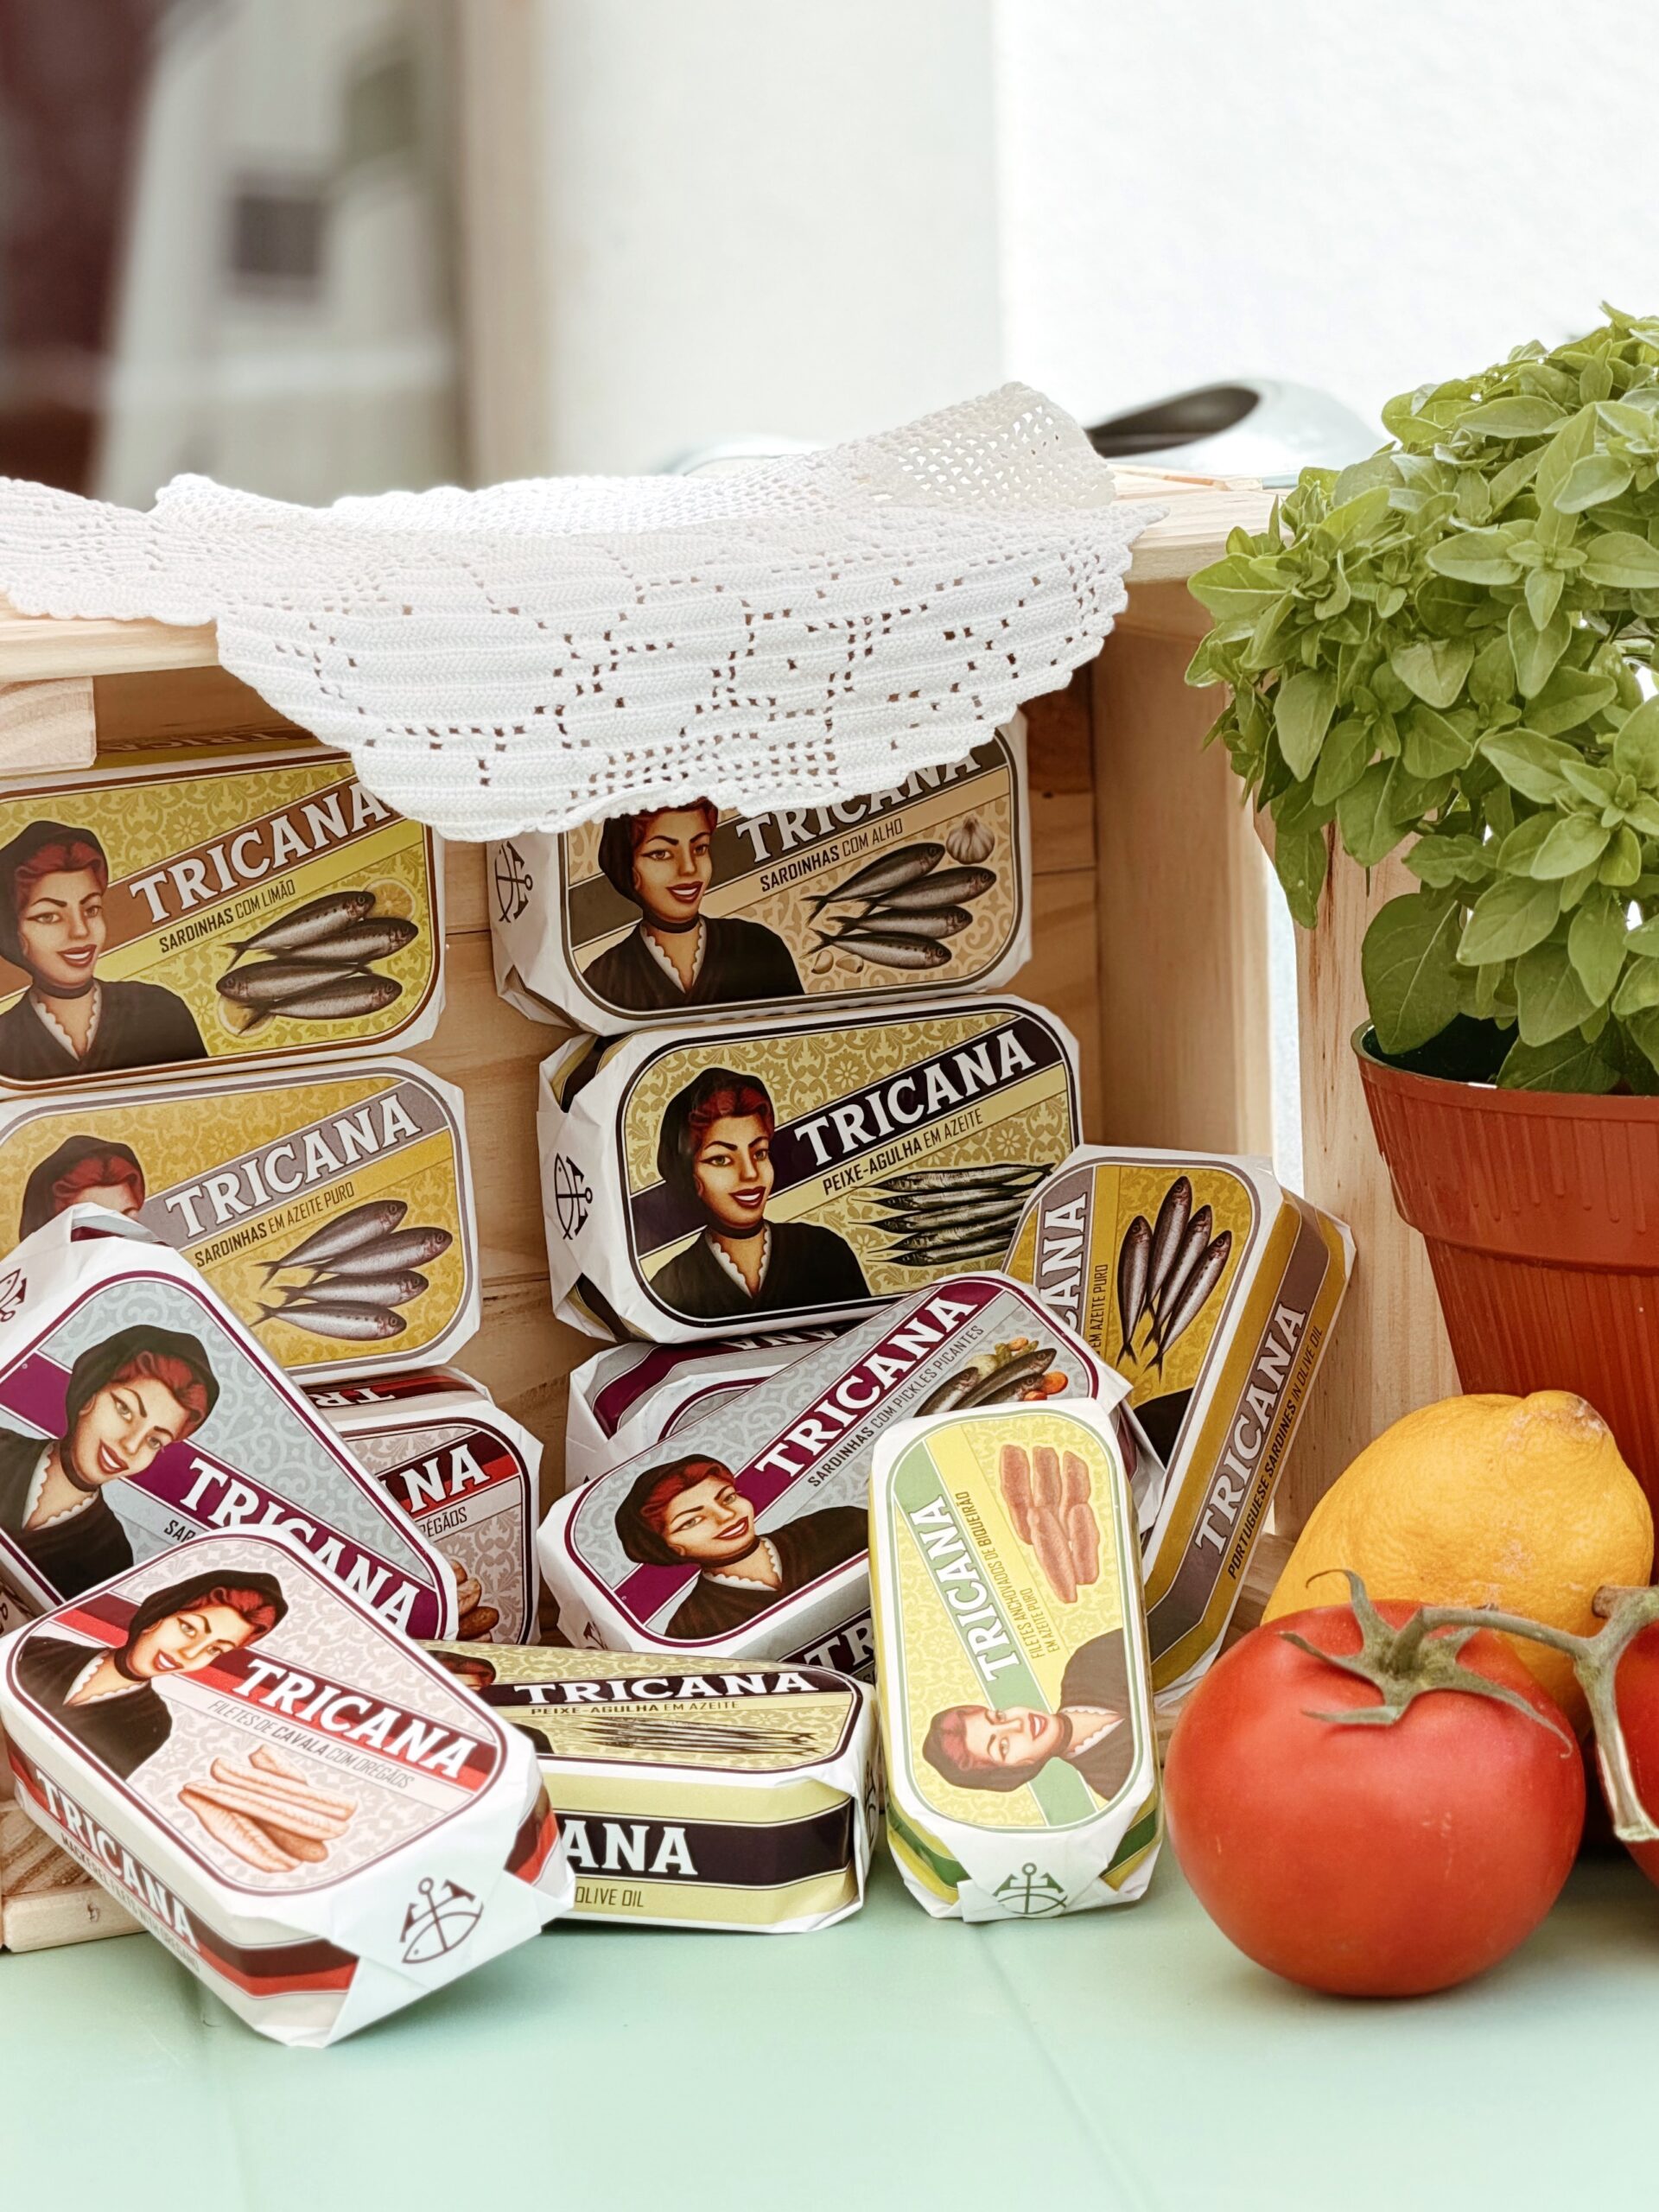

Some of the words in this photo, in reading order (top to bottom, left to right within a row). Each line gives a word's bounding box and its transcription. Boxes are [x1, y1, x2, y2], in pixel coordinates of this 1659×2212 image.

[129, 781, 391, 923] TRICANA
[760, 845, 840, 893] SARDINHAS
[842, 832, 869, 858] COM
[872, 817, 904, 850] ALHO
[160, 908, 233, 953] SARDINHAS
[235, 893, 260, 919] COM
[263, 880, 296, 907] LIMÃO
[795, 1028, 1036, 1166] TRICANA
[164, 1093, 423, 1239] TRICANA
[823, 1138, 923, 1195] PEIXE-AGULHA
[924, 1129, 942, 1147] EM
[944, 1108, 983, 1138] AZEITE
[195, 1223, 267, 1268] SARDINHAS
[269, 1212, 286, 1234] EM
[288, 1199, 324, 1226] AZEITE
[324, 1181, 354, 1208] PURO
[1090, 1295, 1105, 1327] AZEITE
[1095, 1264, 1109, 1294] PURO
[1090, 1334, 1102, 1348] EM
[754, 1294, 978, 1478] TRICANA
[808, 1426, 875, 1487] SARDINHAS
[871, 1406, 897, 1429] COM
[895, 1367, 937, 1408] PICKLES
[934, 1325, 984, 1370] PICANTES
[1195, 1302, 1306, 1555] TRICANA
[1228, 1475, 1269, 1580] PORTUGUESE
[1266, 1399, 1297, 1478] SARDINES
[1291, 1383, 1302, 1402] IN
[1297, 1344, 1316, 1383] OLIVE
[1310, 1325, 1323, 1346] OIL
[380, 1443, 491, 1513] NA
[955, 1491, 992, 1548] BIQUEIRÃO
[982, 1546, 999, 1561] DE
[908, 1495, 1020, 1682] TRICANA
[988, 1556, 1028, 1622] ANCHOVADOS
[1020, 1587, 1038, 1609] PURO
[1031, 1606, 1054, 1641] AZEITE
[1019, 1624, 1044, 1659] FILETES
[1046, 1638, 1059, 1653] EM
[232, 1658, 478, 1779] TRICANA
[514, 1672, 820, 1704] TRICANA
[531, 1704, 659, 1714] PEIXE-AGULHA
[664, 1703, 684, 1713] EM
[690, 1700, 740, 1711] AZEITE
[208, 1700, 261, 1727] FILETES
[254, 1718, 277, 1733] DE
[271, 1726, 327, 1756] CAVALA
[324, 1747, 357, 1766] COM
[352, 1756, 415, 1789] ORÉGÃOS
[35, 1768, 200, 1953] TRICANA
[561, 1819, 699, 1875] ANA
[575, 1886, 618, 1906] OLIVE
[621, 1890, 644, 1908] OIL
